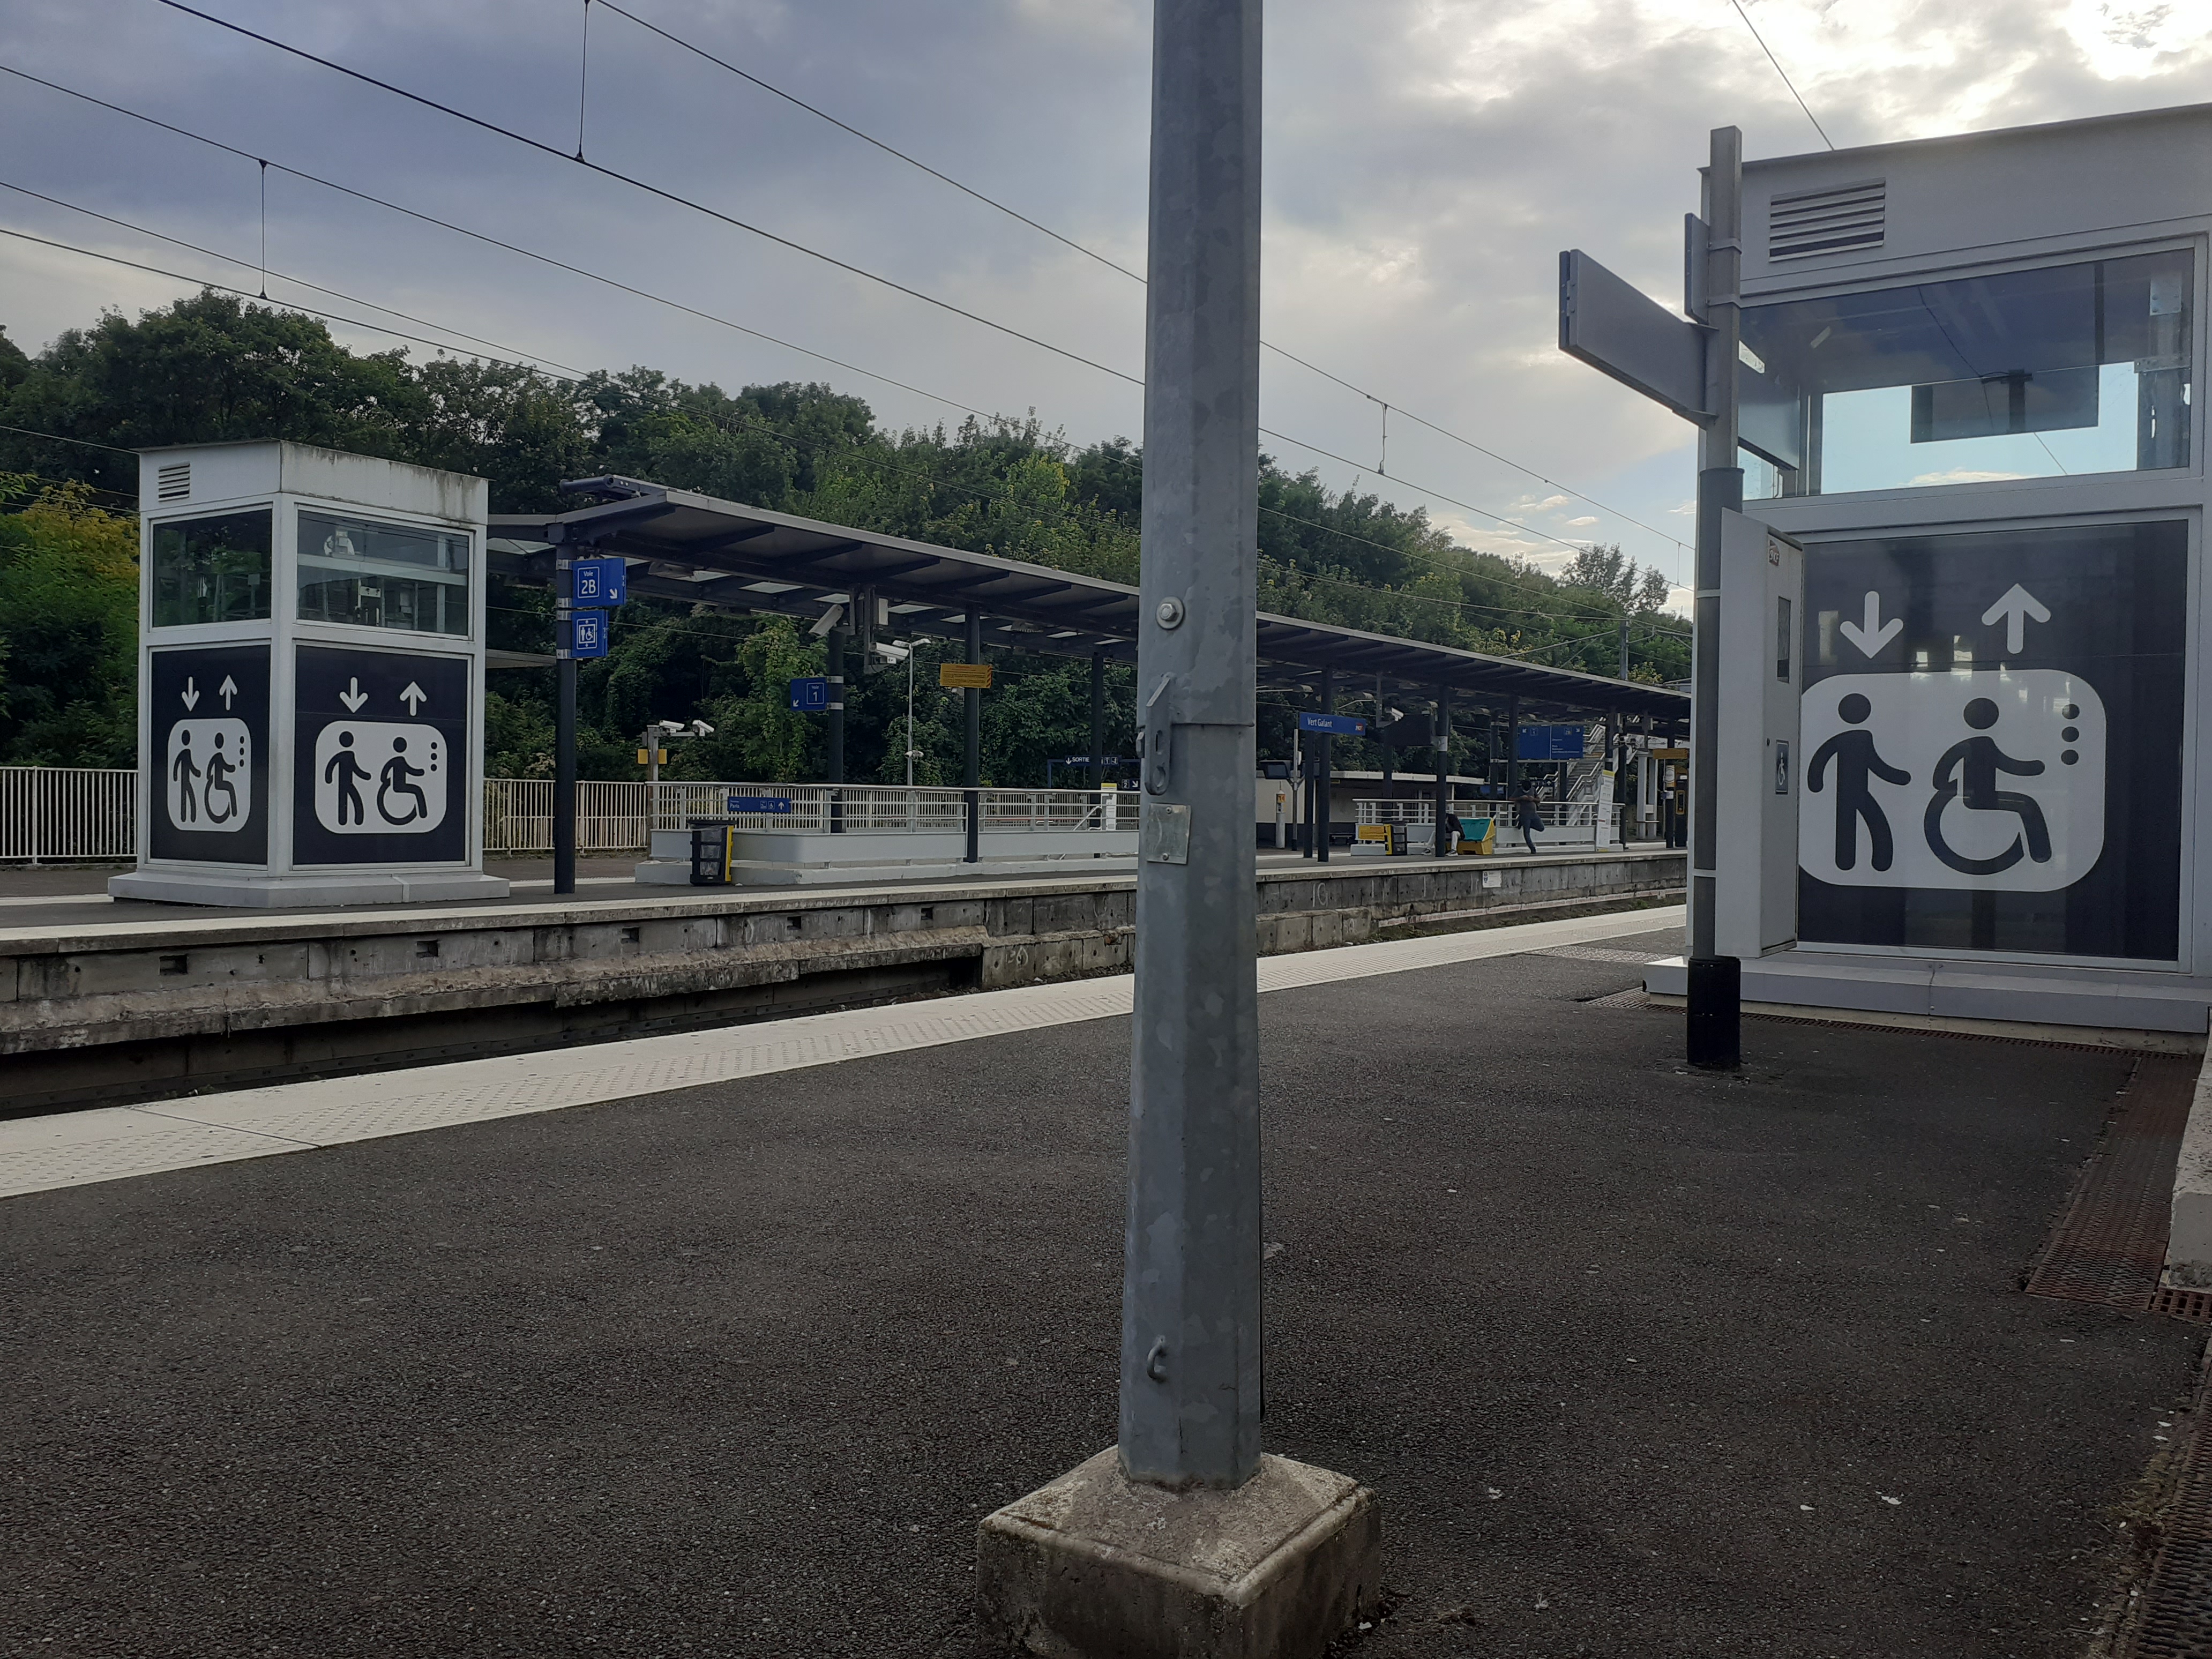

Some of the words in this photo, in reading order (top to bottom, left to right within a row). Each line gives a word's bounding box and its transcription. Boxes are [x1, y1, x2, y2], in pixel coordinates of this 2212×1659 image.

[581, 579, 596, 594] 2B
[813, 691, 817, 701] 1
[1307, 717, 1317, 726] Vert
[1318, 719, 1332, 728] Galant
